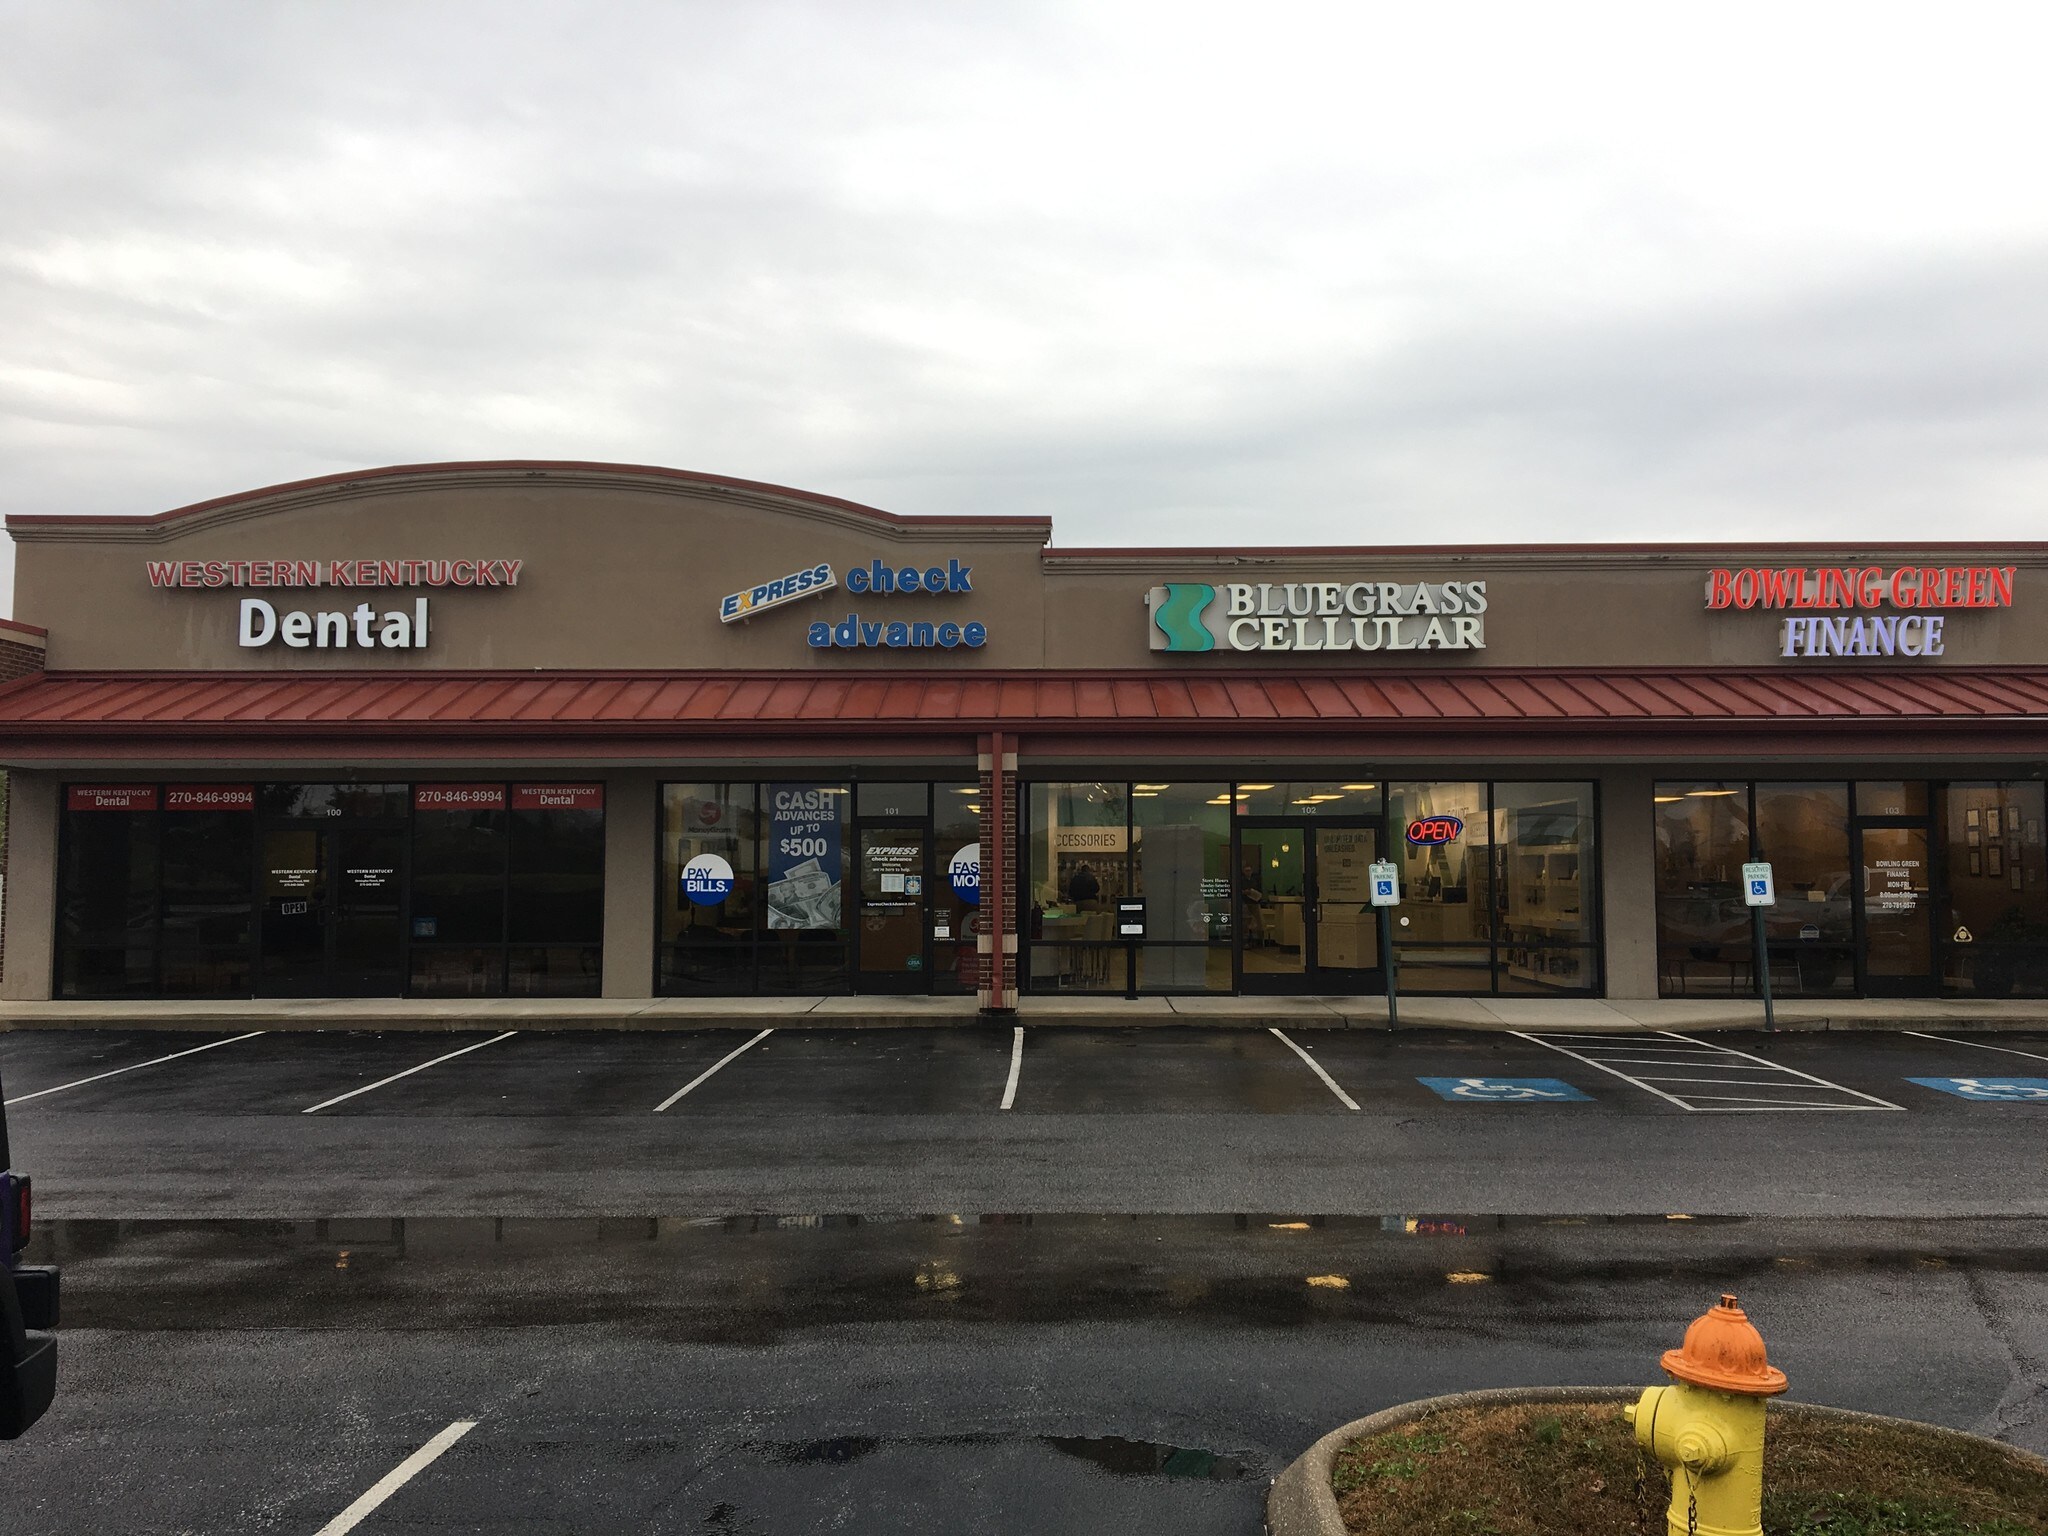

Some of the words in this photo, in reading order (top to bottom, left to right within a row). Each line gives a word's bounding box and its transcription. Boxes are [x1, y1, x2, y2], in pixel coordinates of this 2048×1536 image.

[146, 560, 319, 588] WESTERN
[329, 559, 524, 587] KENTUCKY
[846, 558, 974, 593] check
[722, 563, 831, 618] EXPRESS
[1705, 566, 1883, 610] BOWLING
[1888, 566, 2017, 609] GREEN
[1226, 580, 1488, 617] BLUEGRASS
[238, 597, 430, 648] Dental
[807, 613, 987, 648] advance
[1227, 616, 1487, 652] CELLULAR
[1780, 615, 1945, 657] FINANCE
[95, 796, 130, 806] Dental
[169, 791, 253, 803] 270-846-9994
[418, 791, 502, 802] 270-846-9994
[540, 795, 574, 805] Dental
[775, 791, 835, 810] CASH
[326, 808, 342, 817] 100
[774, 811, 835, 821] ADVANCES
[884, 807, 899, 815] 101
[1301, 806, 1317, 814] 102
[1884, 807, 1900, 815] 103
[790, 826, 804, 836] UP
[806, 823, 820, 833] TO
[1409, 821, 1458, 840] OPEN
[780, 838, 827, 856] $500
[866, 847, 919, 855] EXPRESS
[953, 862, 979, 874] FAS
[1876, 860, 1901, 868] BOWLING
[1901, 860, 1920, 868] GREEN
[687, 868, 712, 879] PAY
[1886, 870, 1910, 878] FINANCE
[687, 881, 729, 892] BILLS.
[283, 902, 306, 914] OPEN
